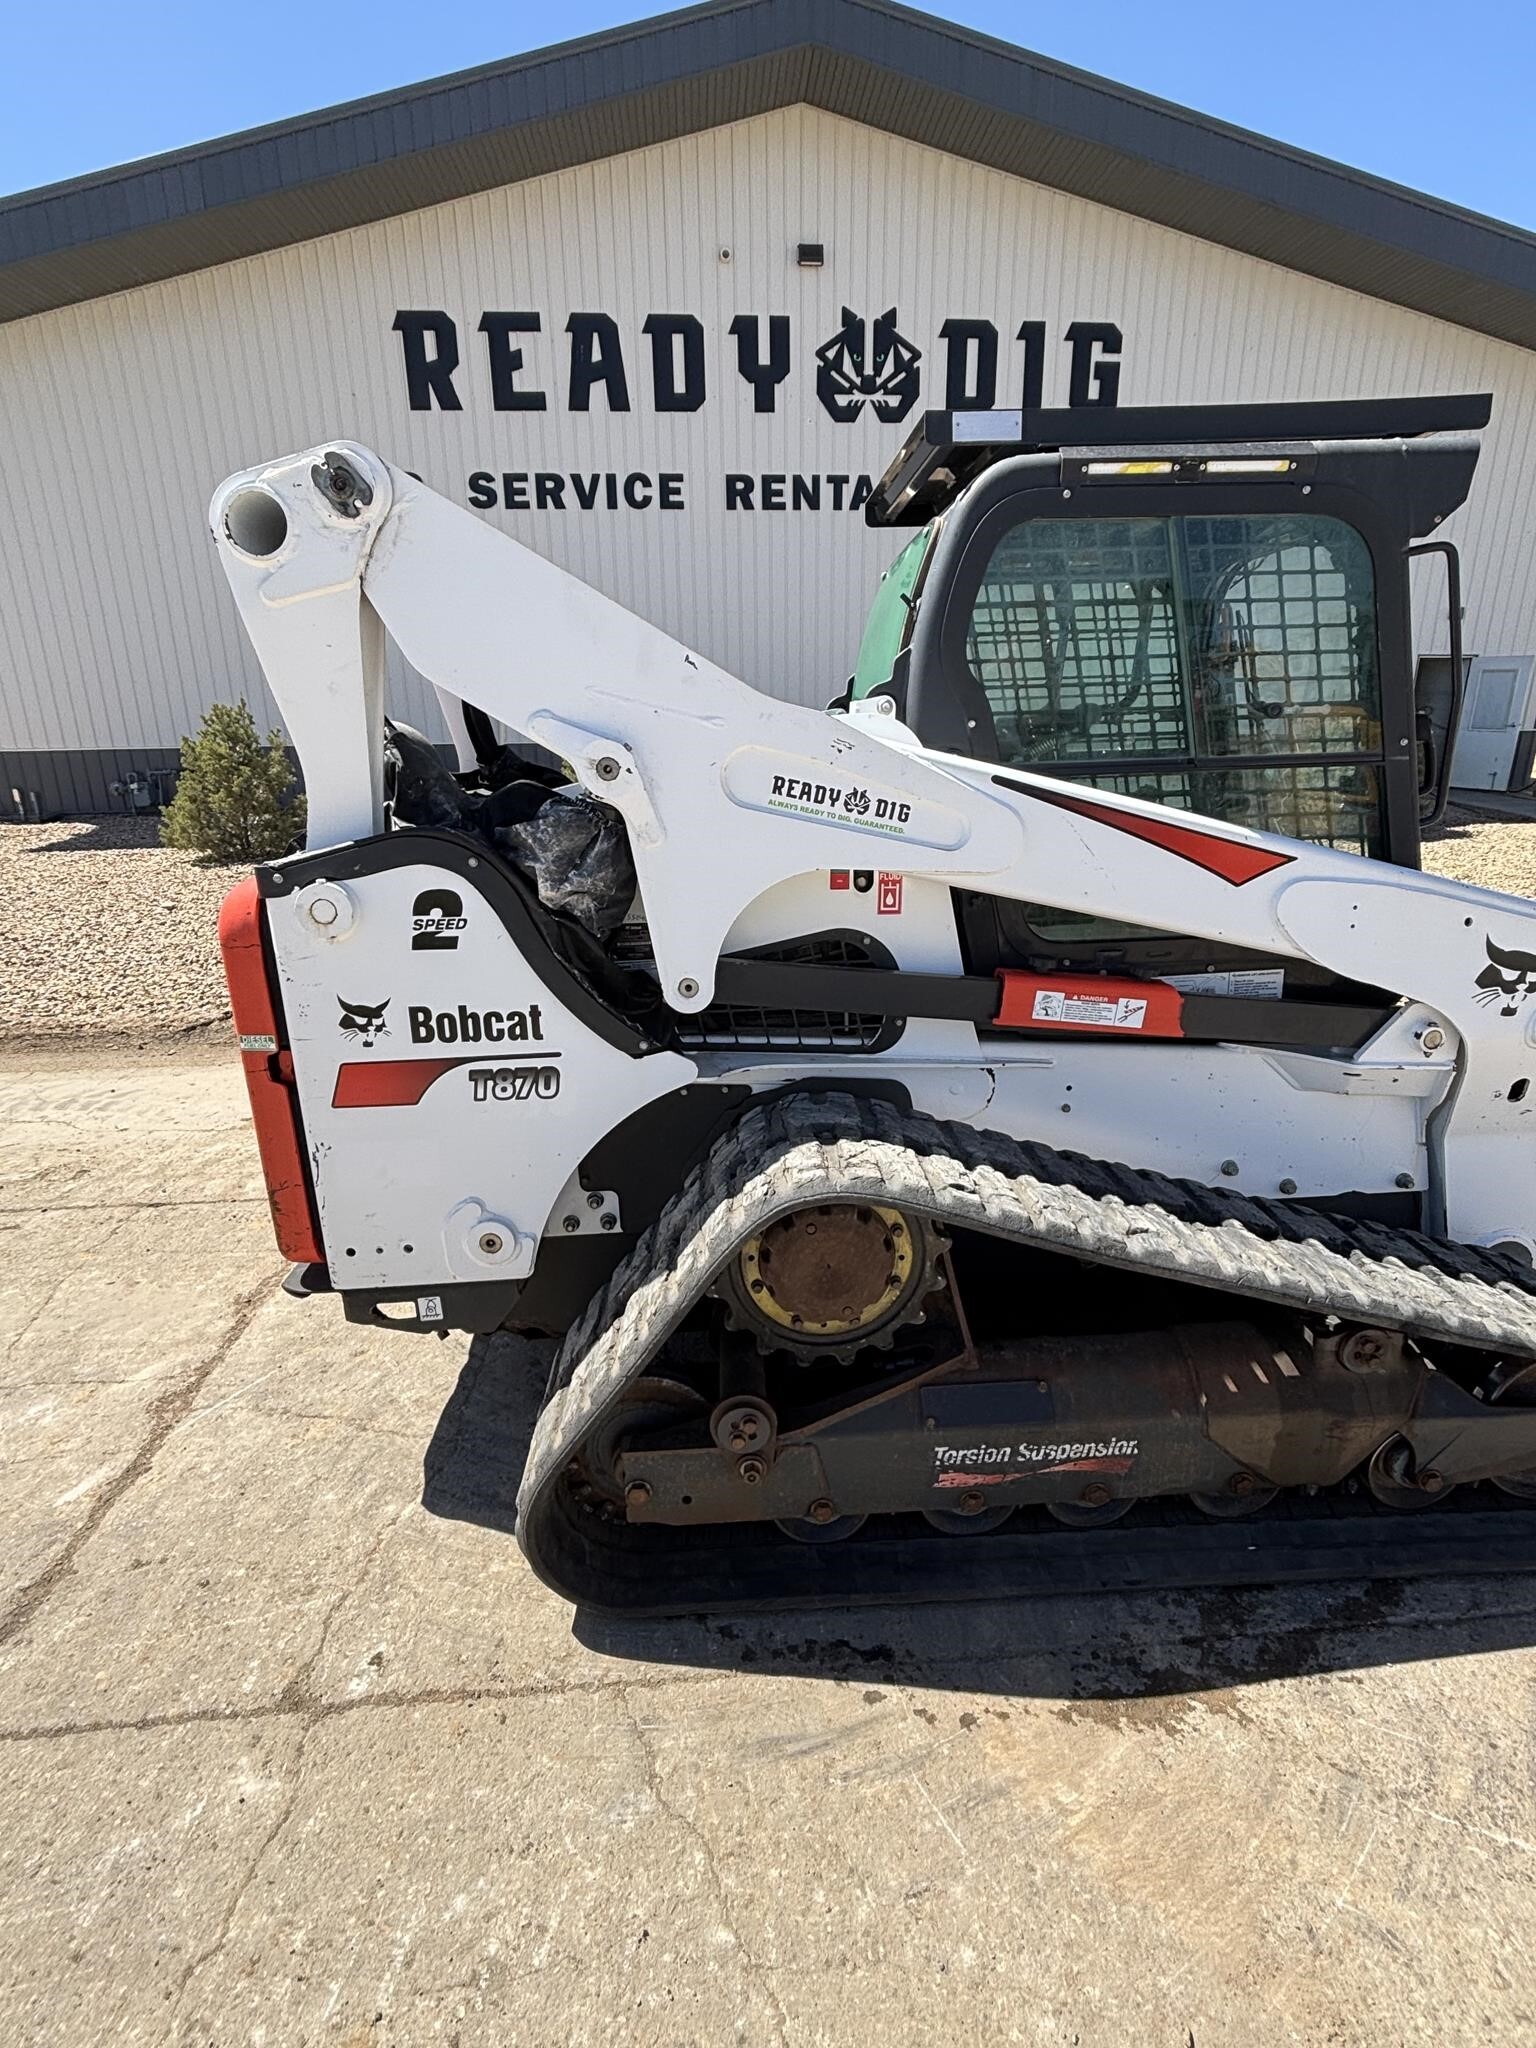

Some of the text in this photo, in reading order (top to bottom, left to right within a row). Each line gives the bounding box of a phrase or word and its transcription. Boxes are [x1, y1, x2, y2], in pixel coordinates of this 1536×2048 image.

[391, 310, 1124, 413] READY DIG
[468, 472, 875, 511] SERVICE RENTA
[768, 799, 798, 811] ALWAYS
[800, 804, 825, 816] READY
[826, 811, 837, 819] TO
[853, 818, 905, 834] GUARANTEED.
[771, 775, 911, 823] READY DIG
[879, 872, 901, 881] FLUID
[412, 889, 463, 950] 2
[412, 917, 468, 931] SPEED
[1080, 994, 1109, 1003] DANGER
[242, 1035, 272, 1043] DIESEL
[408, 1004, 544, 1043] Bobcat
[468, 1065, 561, 1102] T870
[934, 1437, 1139, 1466] Torsion Suspension
